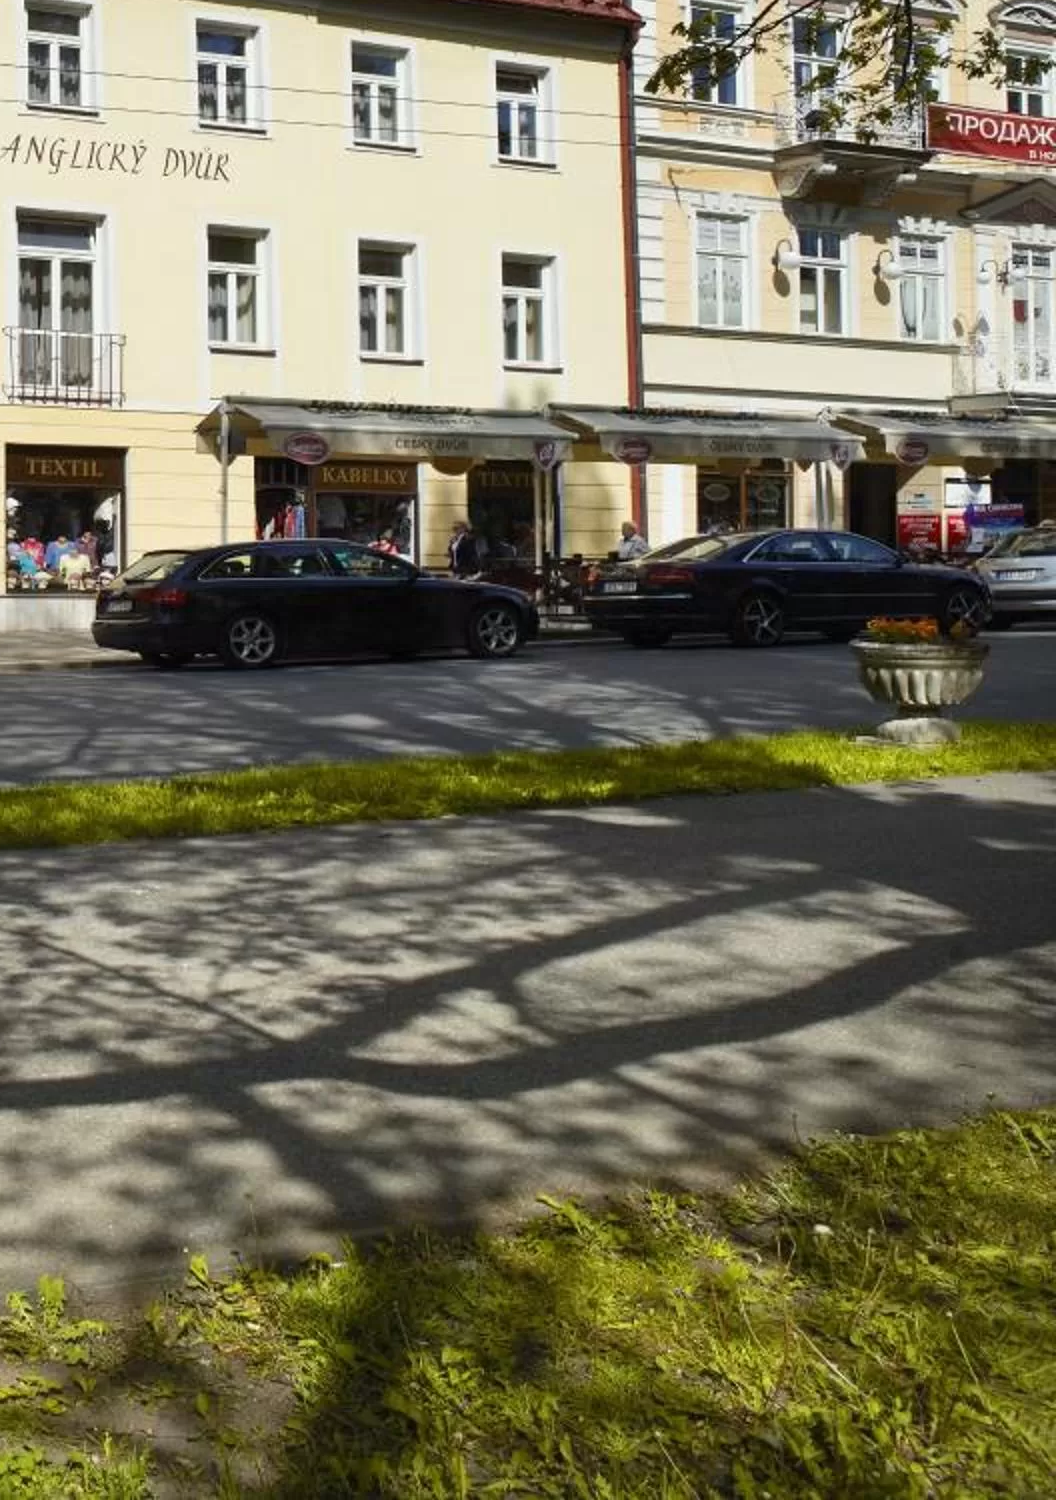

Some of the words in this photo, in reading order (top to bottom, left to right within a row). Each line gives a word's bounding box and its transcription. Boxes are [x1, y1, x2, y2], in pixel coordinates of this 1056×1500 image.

[945, 113, 1056, 147] ПРОДАЖ
[163, 147, 231, 182] DVŮR
[26, 456, 105, 478] TEXTIL
[322, 467, 409, 485] KABELKY
[479, 471, 533, 488] TEXTI
